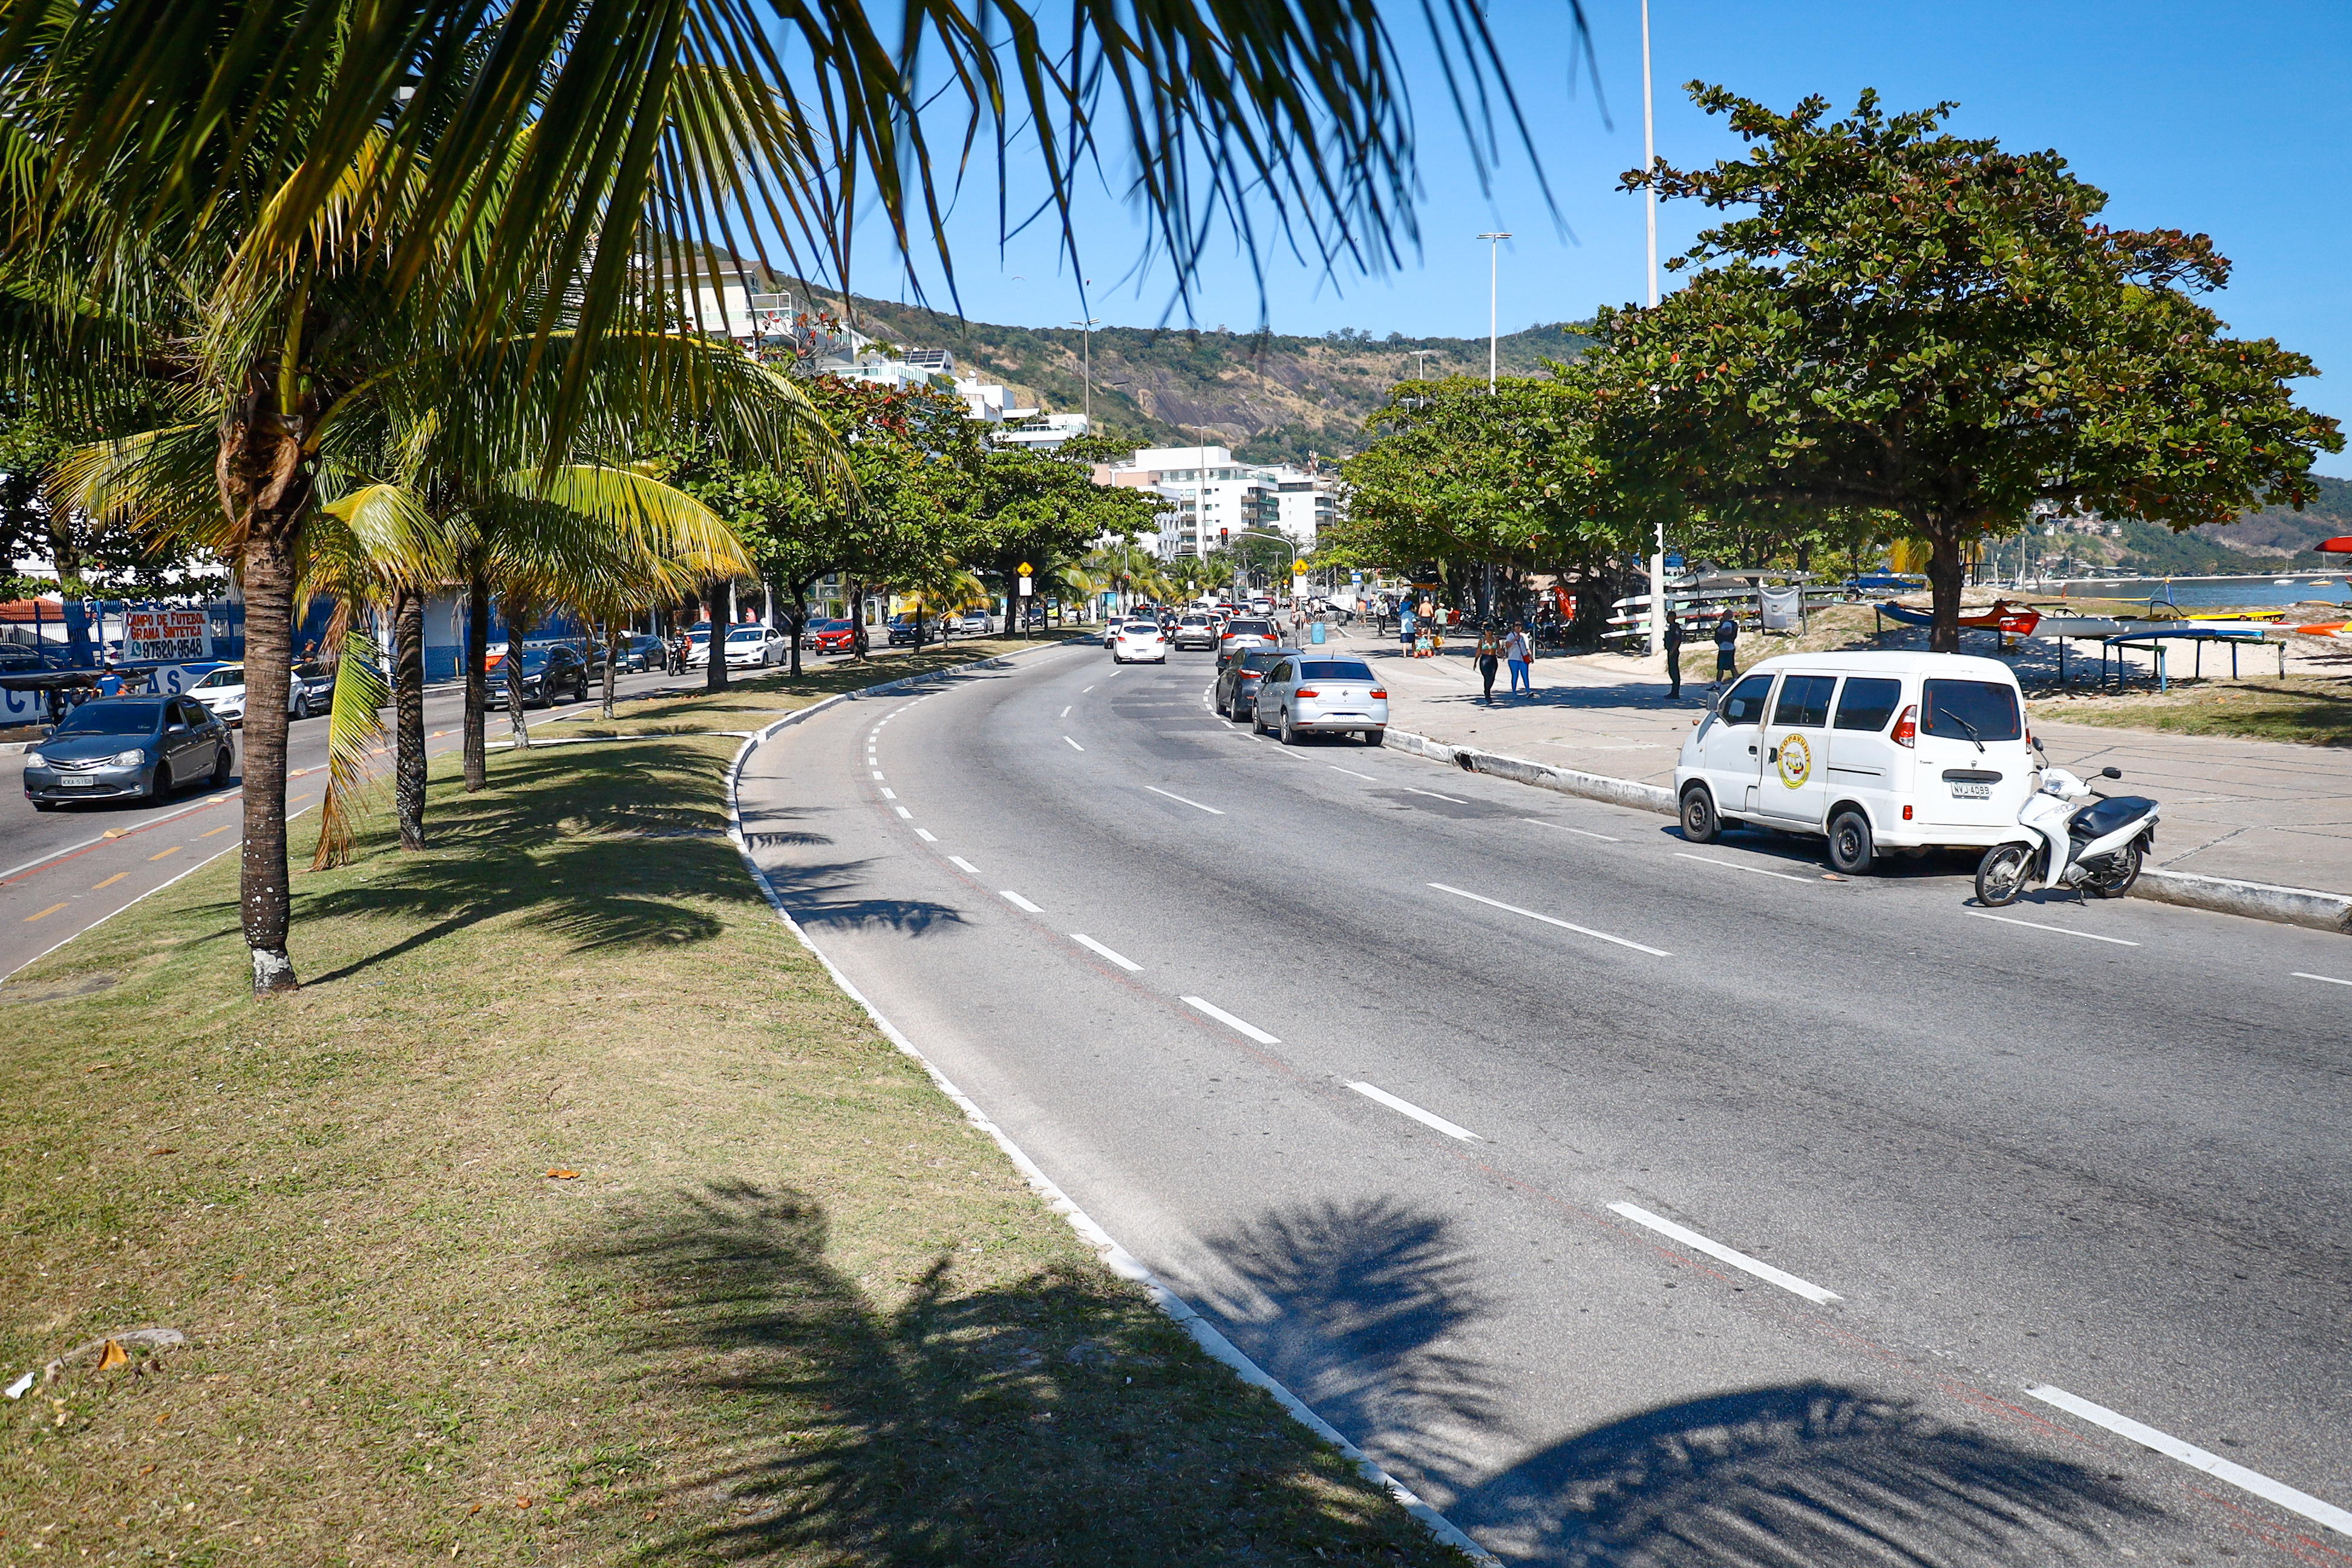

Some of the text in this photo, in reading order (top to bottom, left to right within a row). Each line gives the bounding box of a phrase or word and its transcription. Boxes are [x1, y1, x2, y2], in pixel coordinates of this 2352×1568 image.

[126, 612, 206, 627] CAMPO DE FUTEBOL
[131, 626, 160, 640] GRAMA
